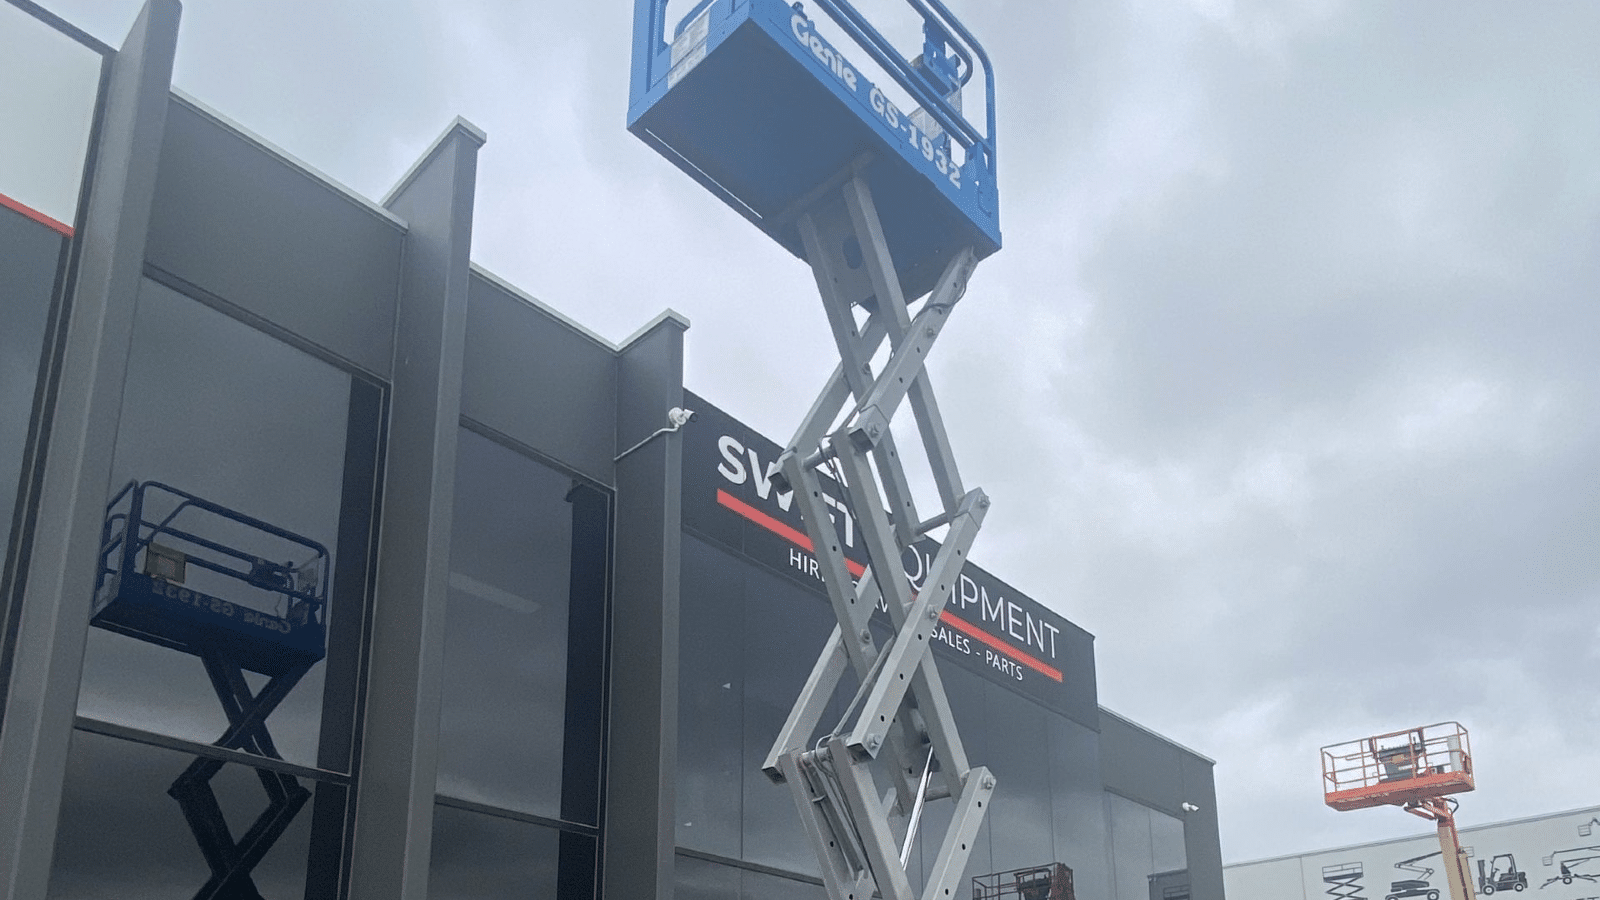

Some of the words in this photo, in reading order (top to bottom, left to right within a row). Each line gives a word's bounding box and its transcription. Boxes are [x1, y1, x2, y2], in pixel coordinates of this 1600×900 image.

[791, 14, 858, 92] Genie
[869, 87, 961, 190] GS-1932
[789, 548, 826, 583] HIR
[985, 649, 1024, 681] PARTS
